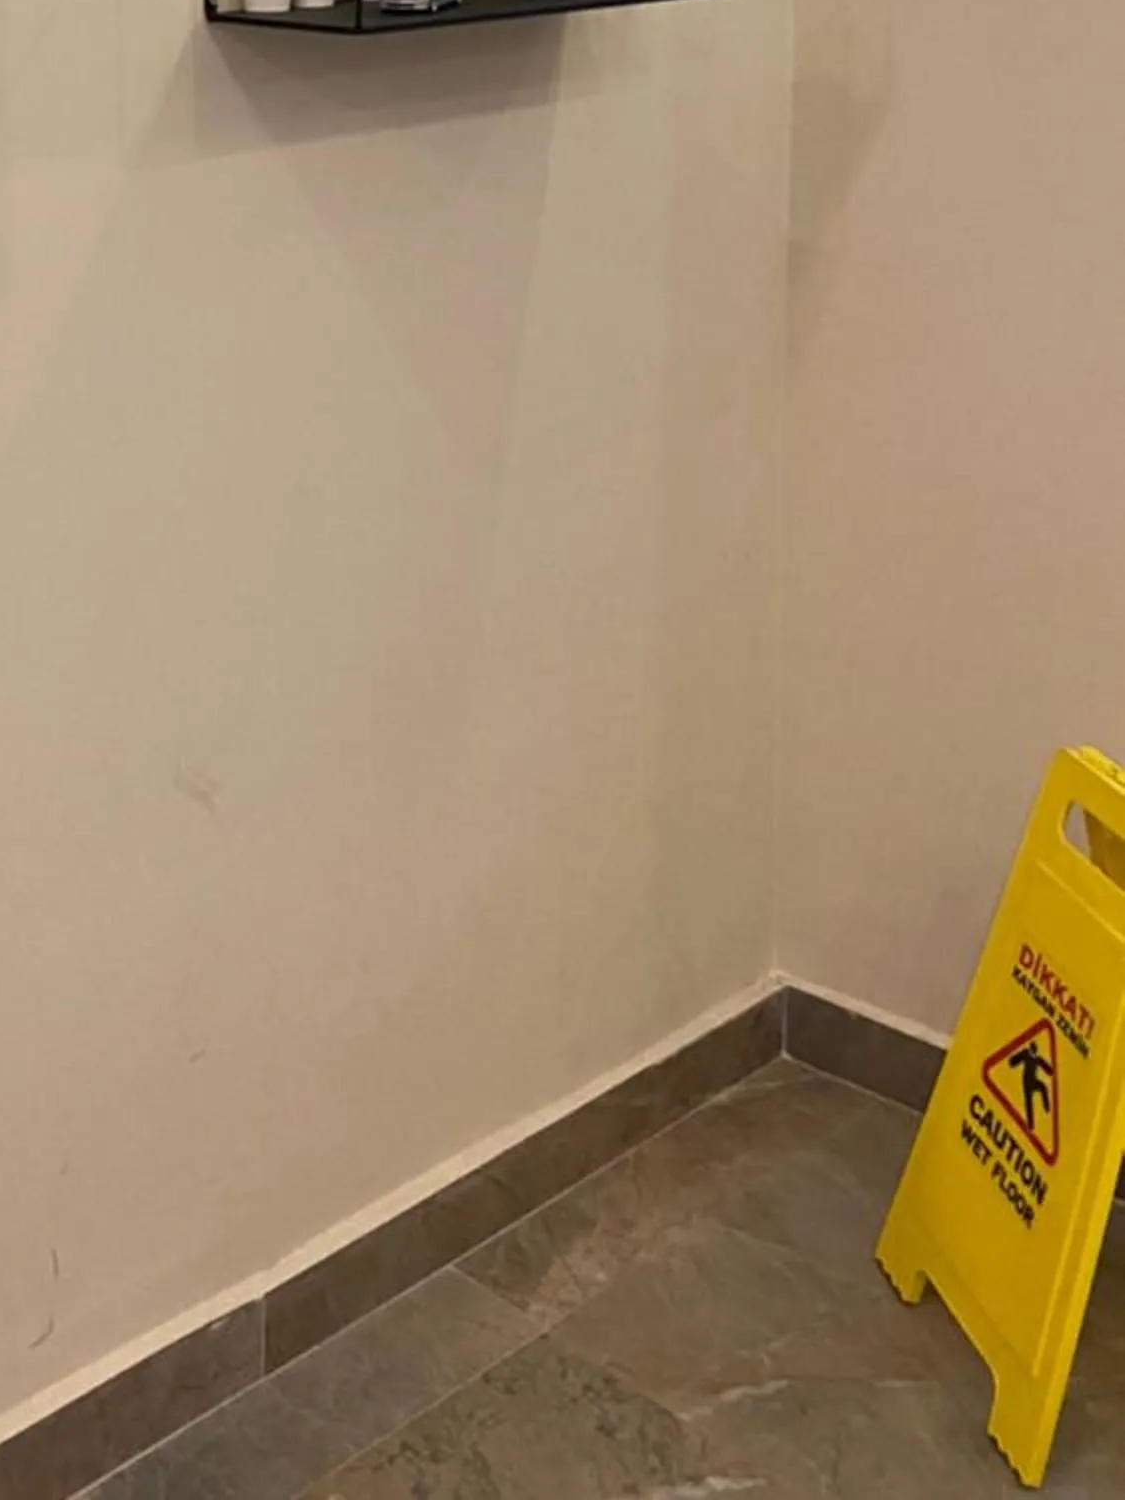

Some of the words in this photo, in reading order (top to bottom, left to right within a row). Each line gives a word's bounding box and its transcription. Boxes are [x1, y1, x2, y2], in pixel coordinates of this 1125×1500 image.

[1012, 965, 1055, 1017] KAYGAN
[962, 1120, 992, 1165] WET
[991, 1162, 1034, 1229] FLOOR
[970, 1094, 1047, 1204] CAUTION
